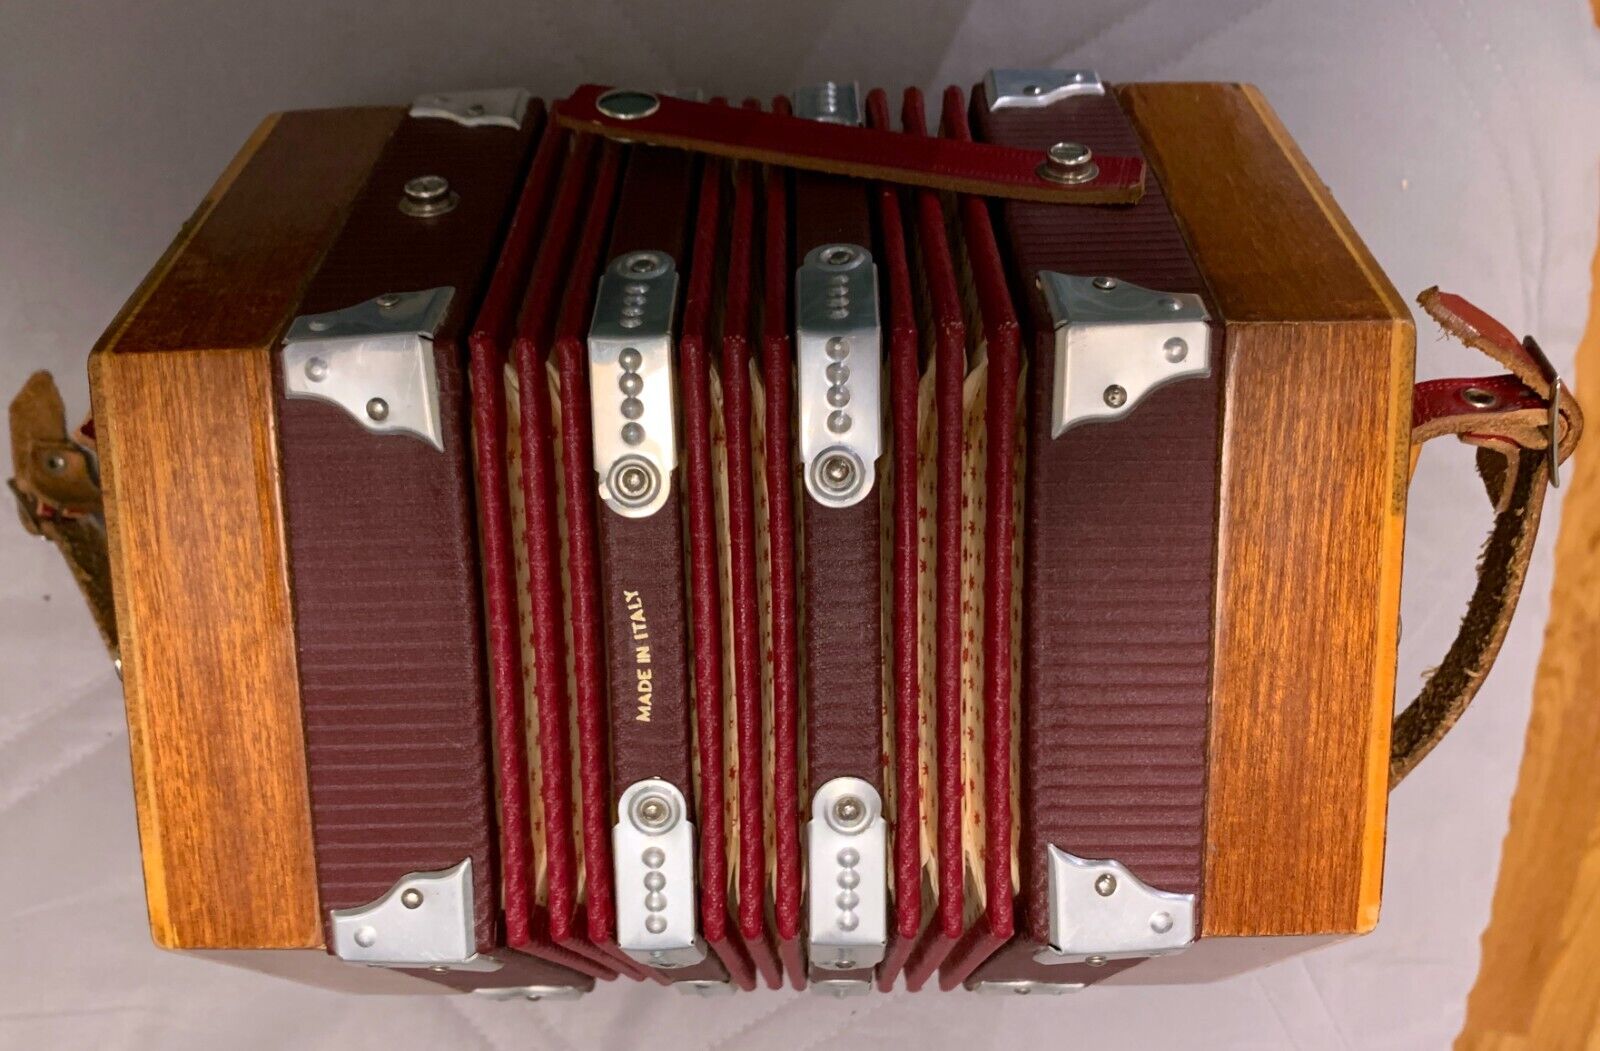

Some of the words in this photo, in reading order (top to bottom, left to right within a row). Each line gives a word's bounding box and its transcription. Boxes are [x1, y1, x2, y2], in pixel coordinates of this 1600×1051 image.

[623, 590, 649, 640] ITALY
[635, 646, 652, 664] IN
[635, 668, 653, 722] MADE
